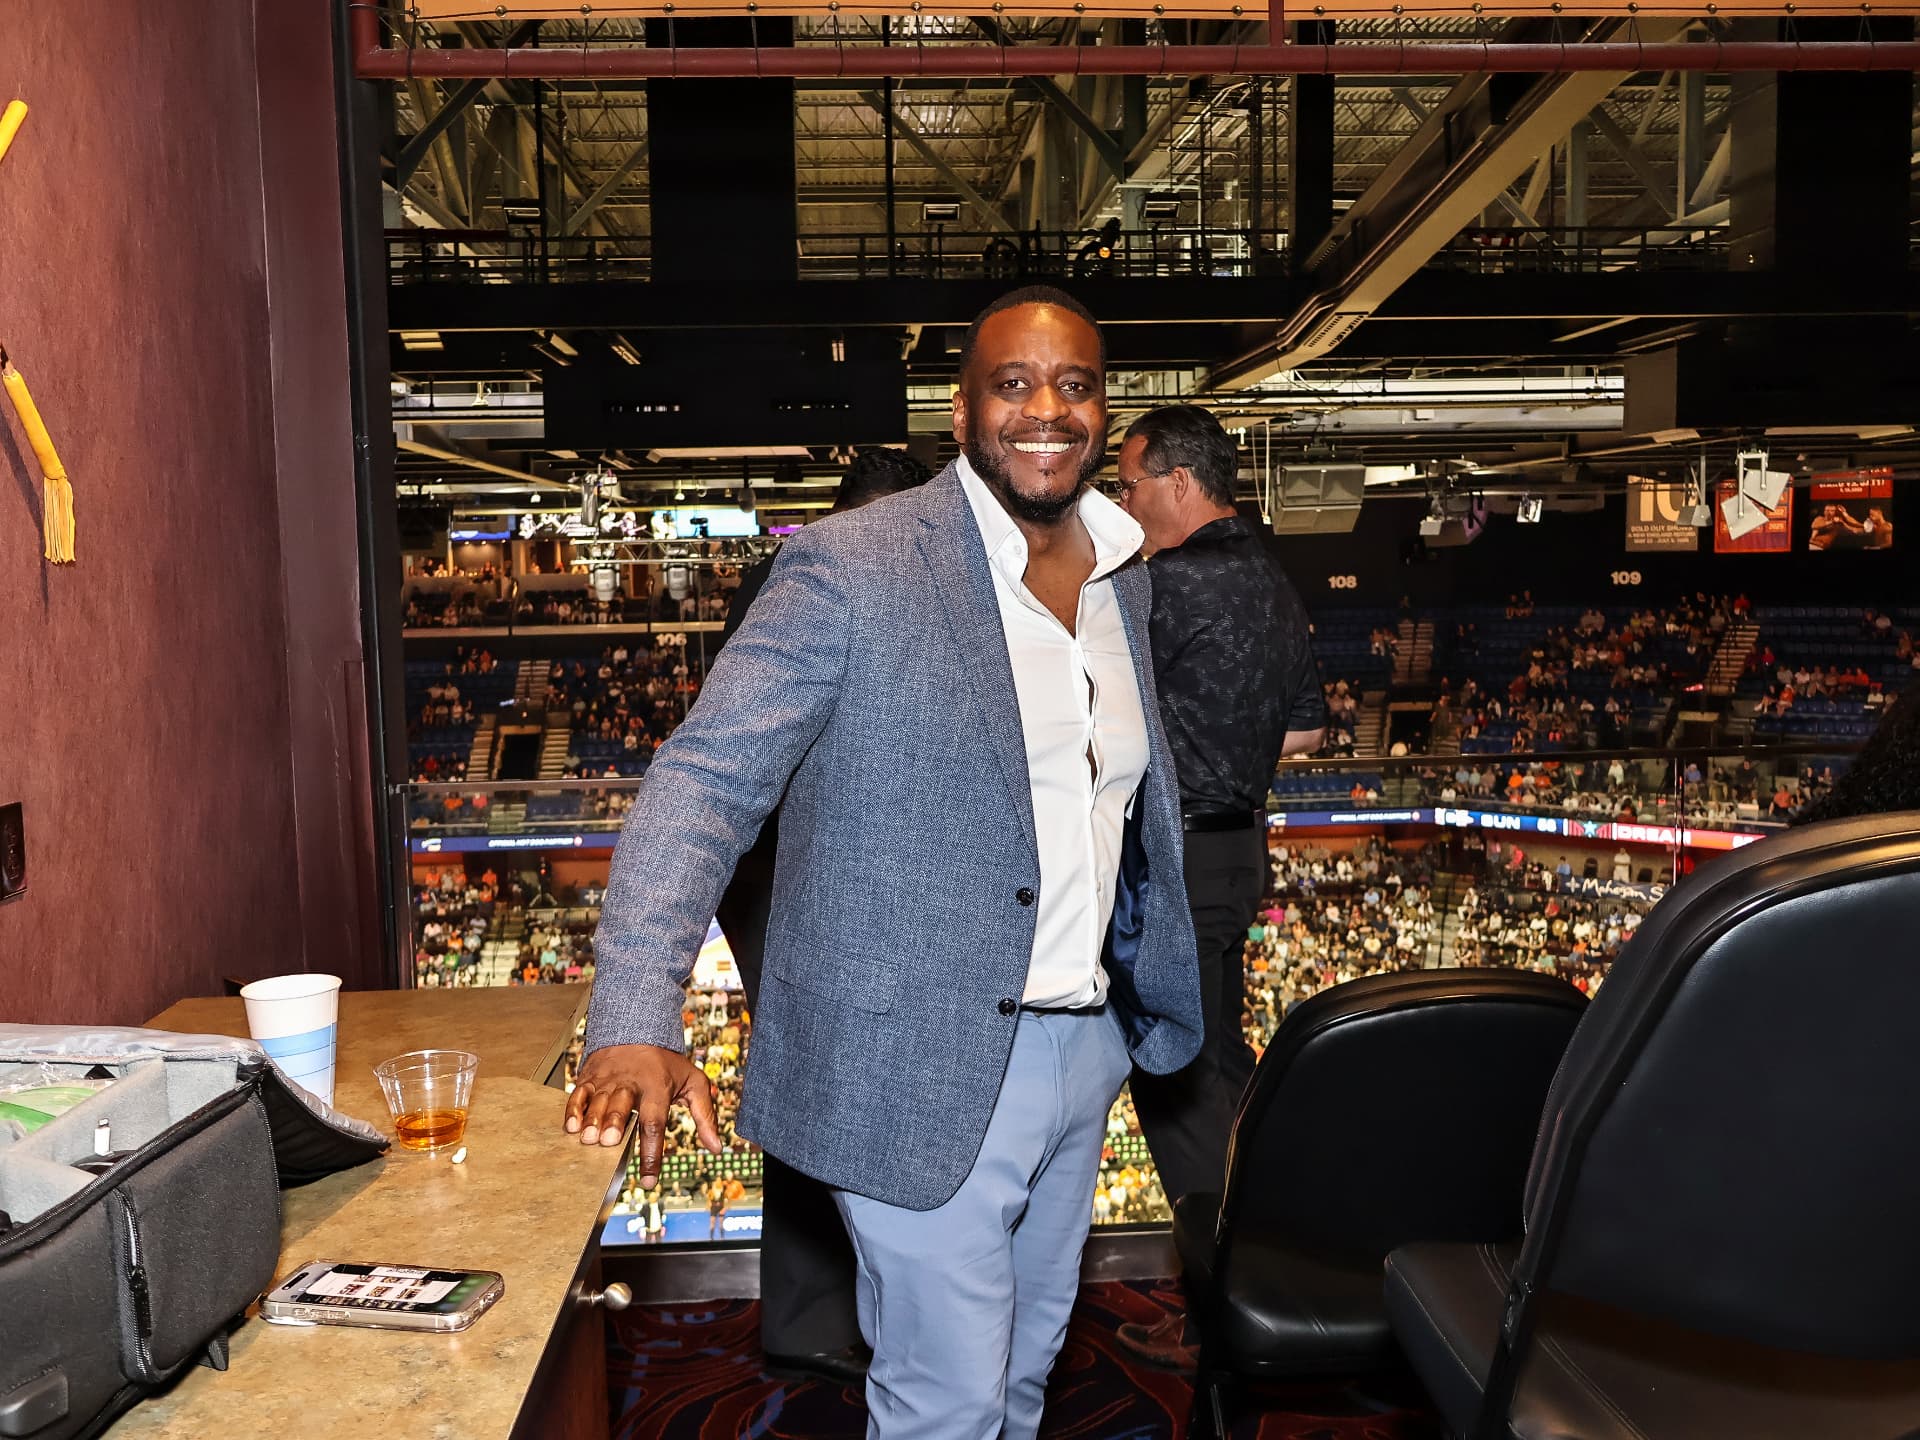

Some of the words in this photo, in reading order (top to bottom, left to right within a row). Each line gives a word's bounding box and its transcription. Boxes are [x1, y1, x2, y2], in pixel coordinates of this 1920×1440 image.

[1328, 575, 1357, 588] 108
[1610, 571, 1642, 585] 109
[655, 633, 687, 646] 106
[1617, 825, 1692, 845] DREAM
